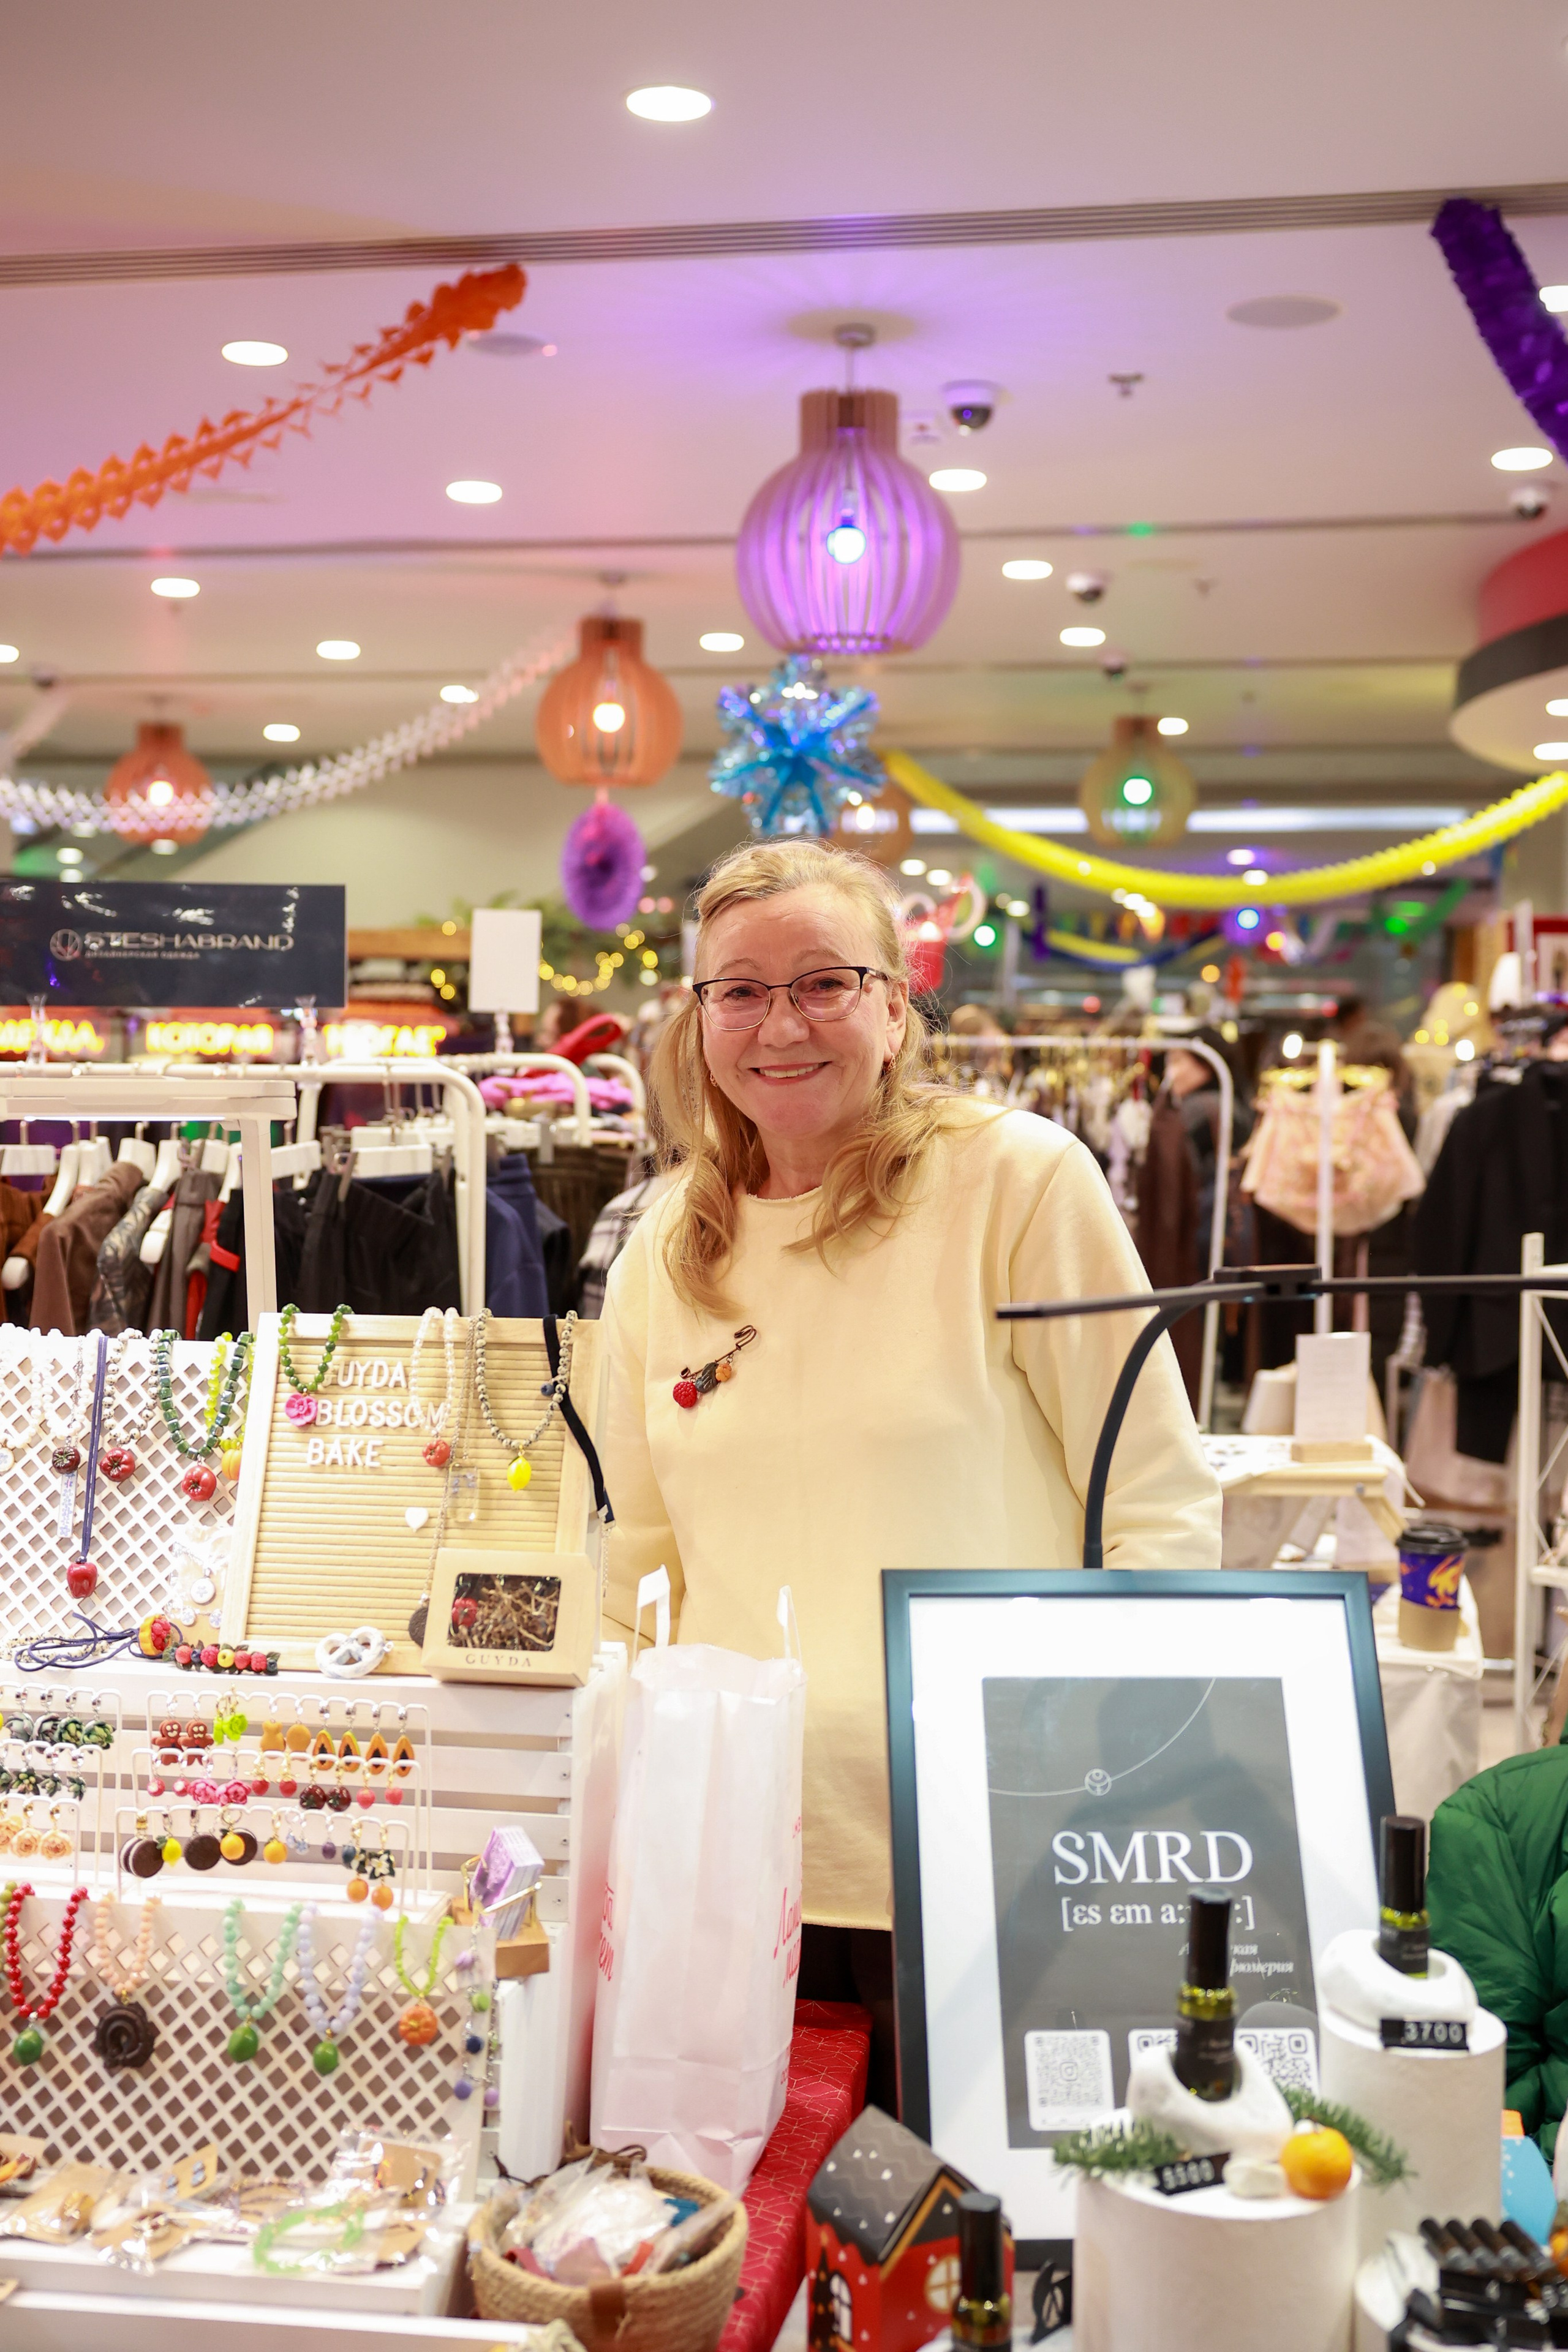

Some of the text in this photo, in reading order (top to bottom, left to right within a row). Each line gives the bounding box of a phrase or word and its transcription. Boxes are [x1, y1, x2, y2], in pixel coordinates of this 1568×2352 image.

[307, 1438, 383, 1468] BAKE
[465, 1654, 532, 1667] GUYDA
[1052, 1830, 1253, 1885] SMRD
[1404, 2021, 1463, 2044] 3700
